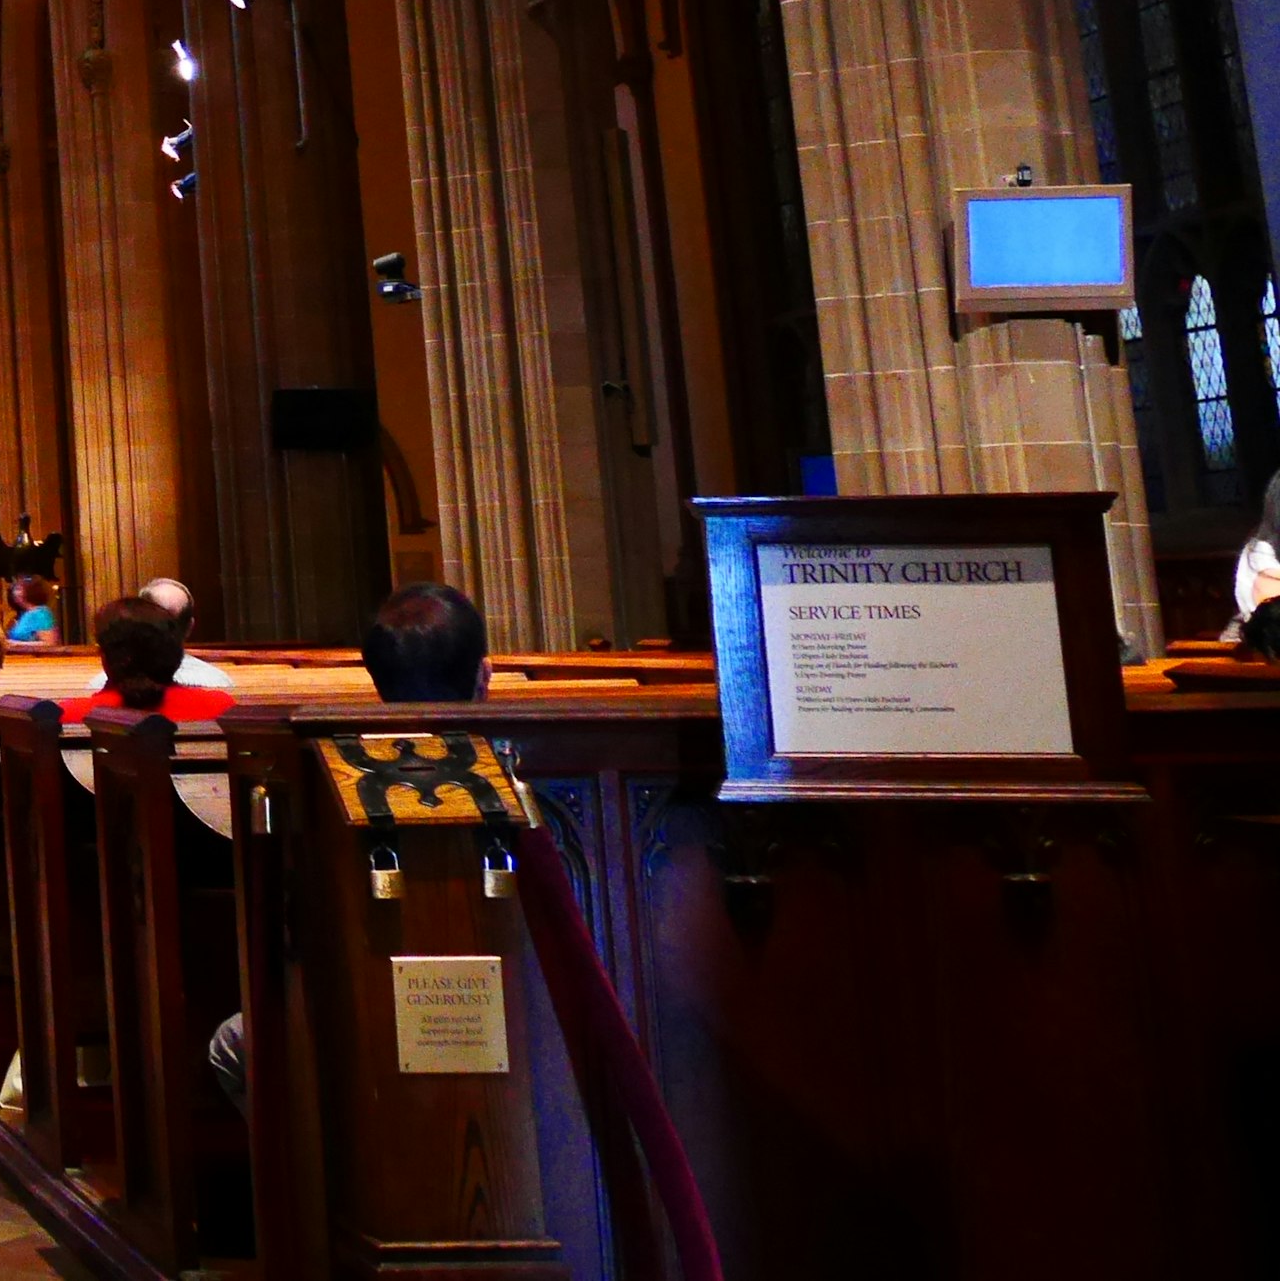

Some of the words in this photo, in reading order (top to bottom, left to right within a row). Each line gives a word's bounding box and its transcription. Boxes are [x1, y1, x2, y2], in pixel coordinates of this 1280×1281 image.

[783, 544, 852, 560] Welcome
[856, 545, 871, 558] to
[782, 561, 894, 584] TRINITY
[900, 560, 1024, 584] CHURCH
[788, 605, 861, 620] SERVICE
[863, 604, 921, 619] TIMES
[408, 977, 453, 990] PLEASE
[456, 976, 490, 990] GIVE
[406, 994, 491, 1006] GENEROUSLY
